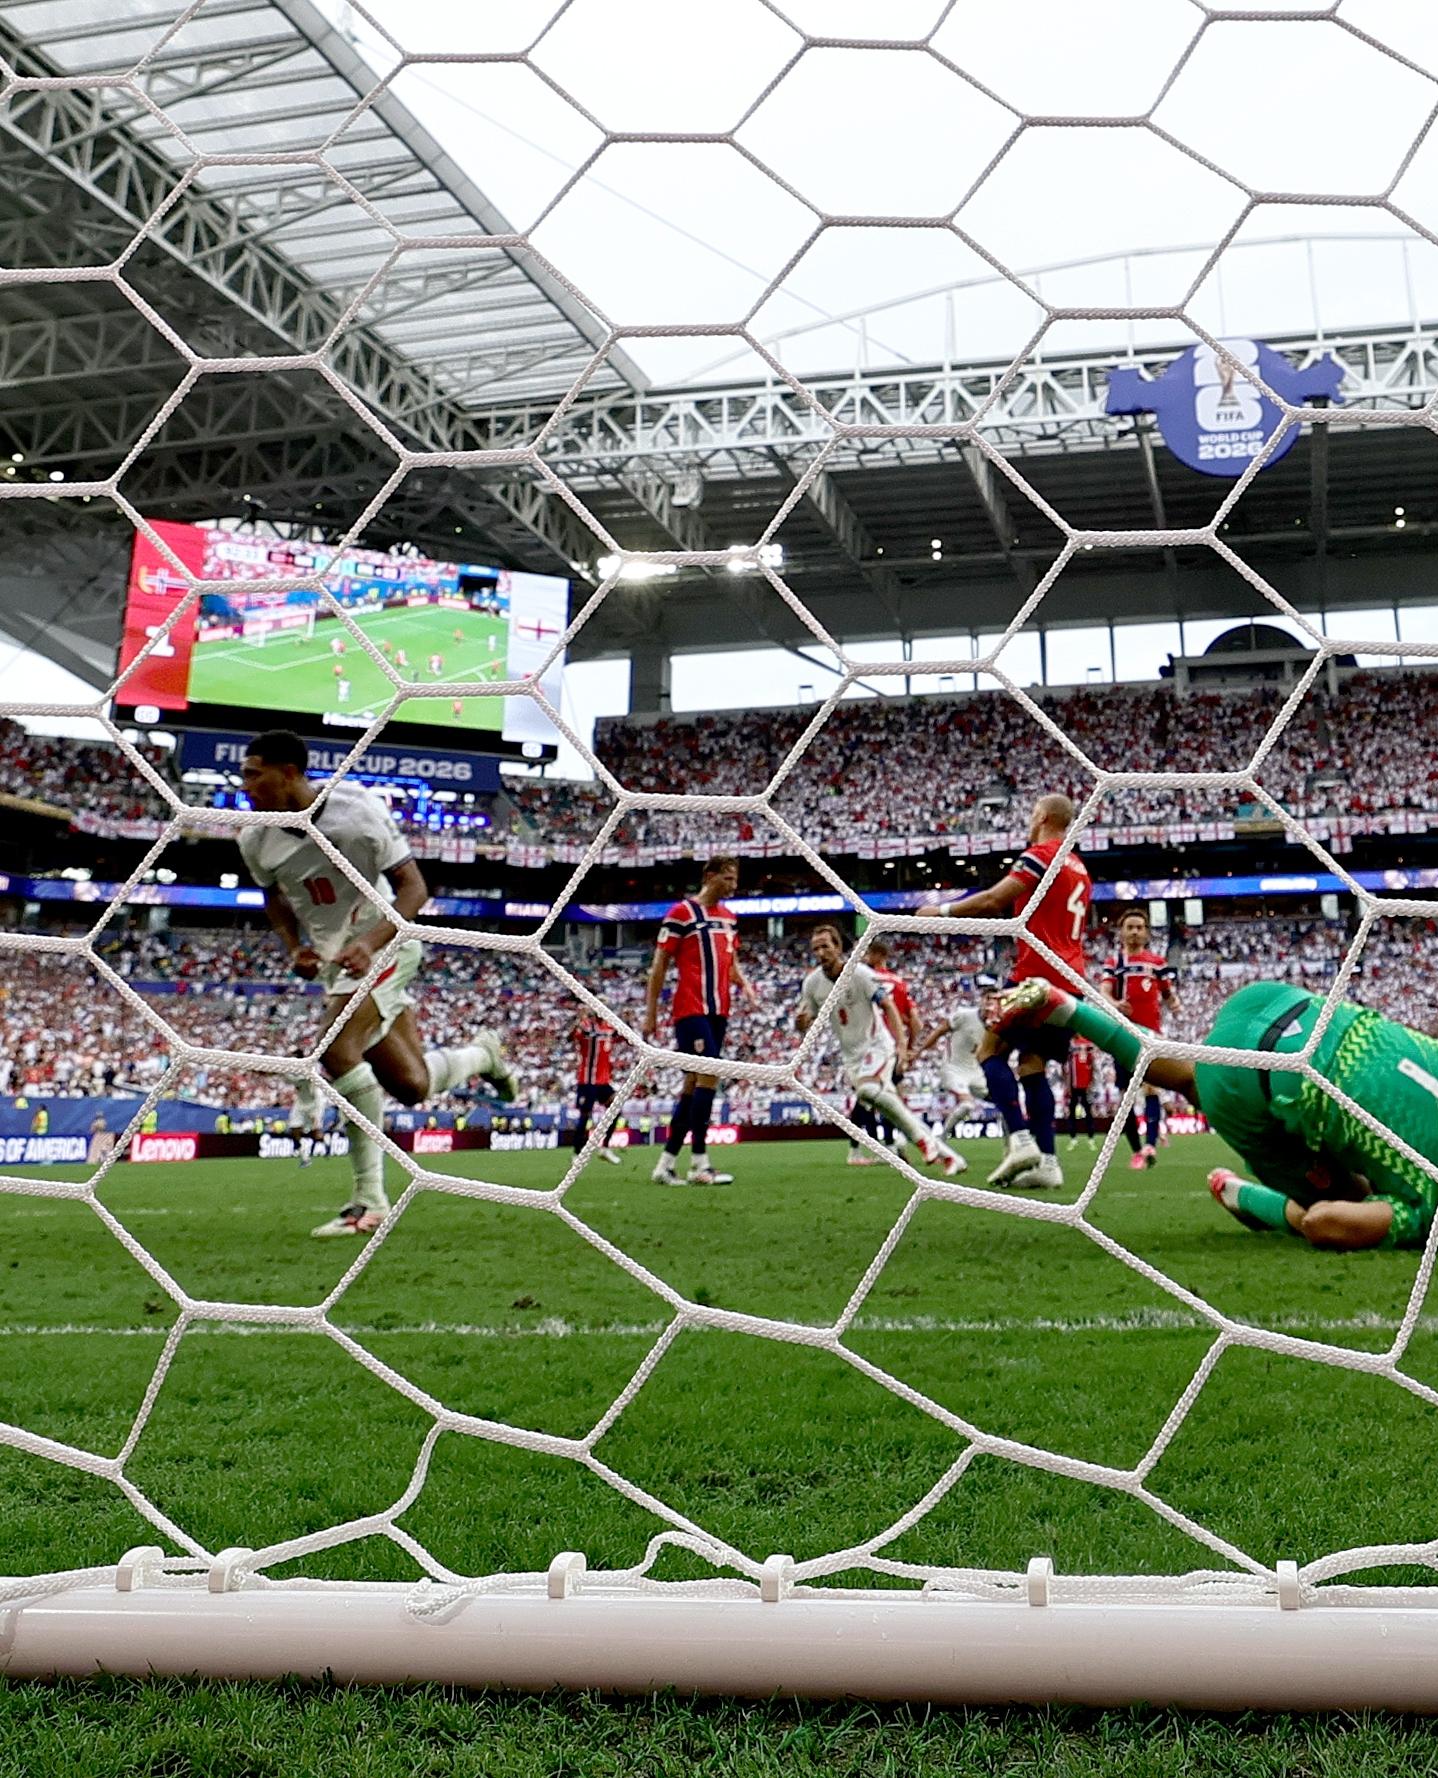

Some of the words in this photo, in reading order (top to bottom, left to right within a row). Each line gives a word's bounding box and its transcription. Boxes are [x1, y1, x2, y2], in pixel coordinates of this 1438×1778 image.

[1215, 410, 1245, 423] FIFA
[1197, 432, 1239, 444] WORLD
[1240, 430, 1264, 441] CUP
[1198, 441, 1264, 460] 2026
[353, 753, 396, 774] CUP
[399, 758, 473, 781] 2026
[1066, 880, 1087, 940] 4
[954, 1120, 983, 1138] for
[5, 1137, 26, 1163] OF
[25, 1136, 87, 1162] AMERICA
[130, 1133, 196, 1162] Lenovo
